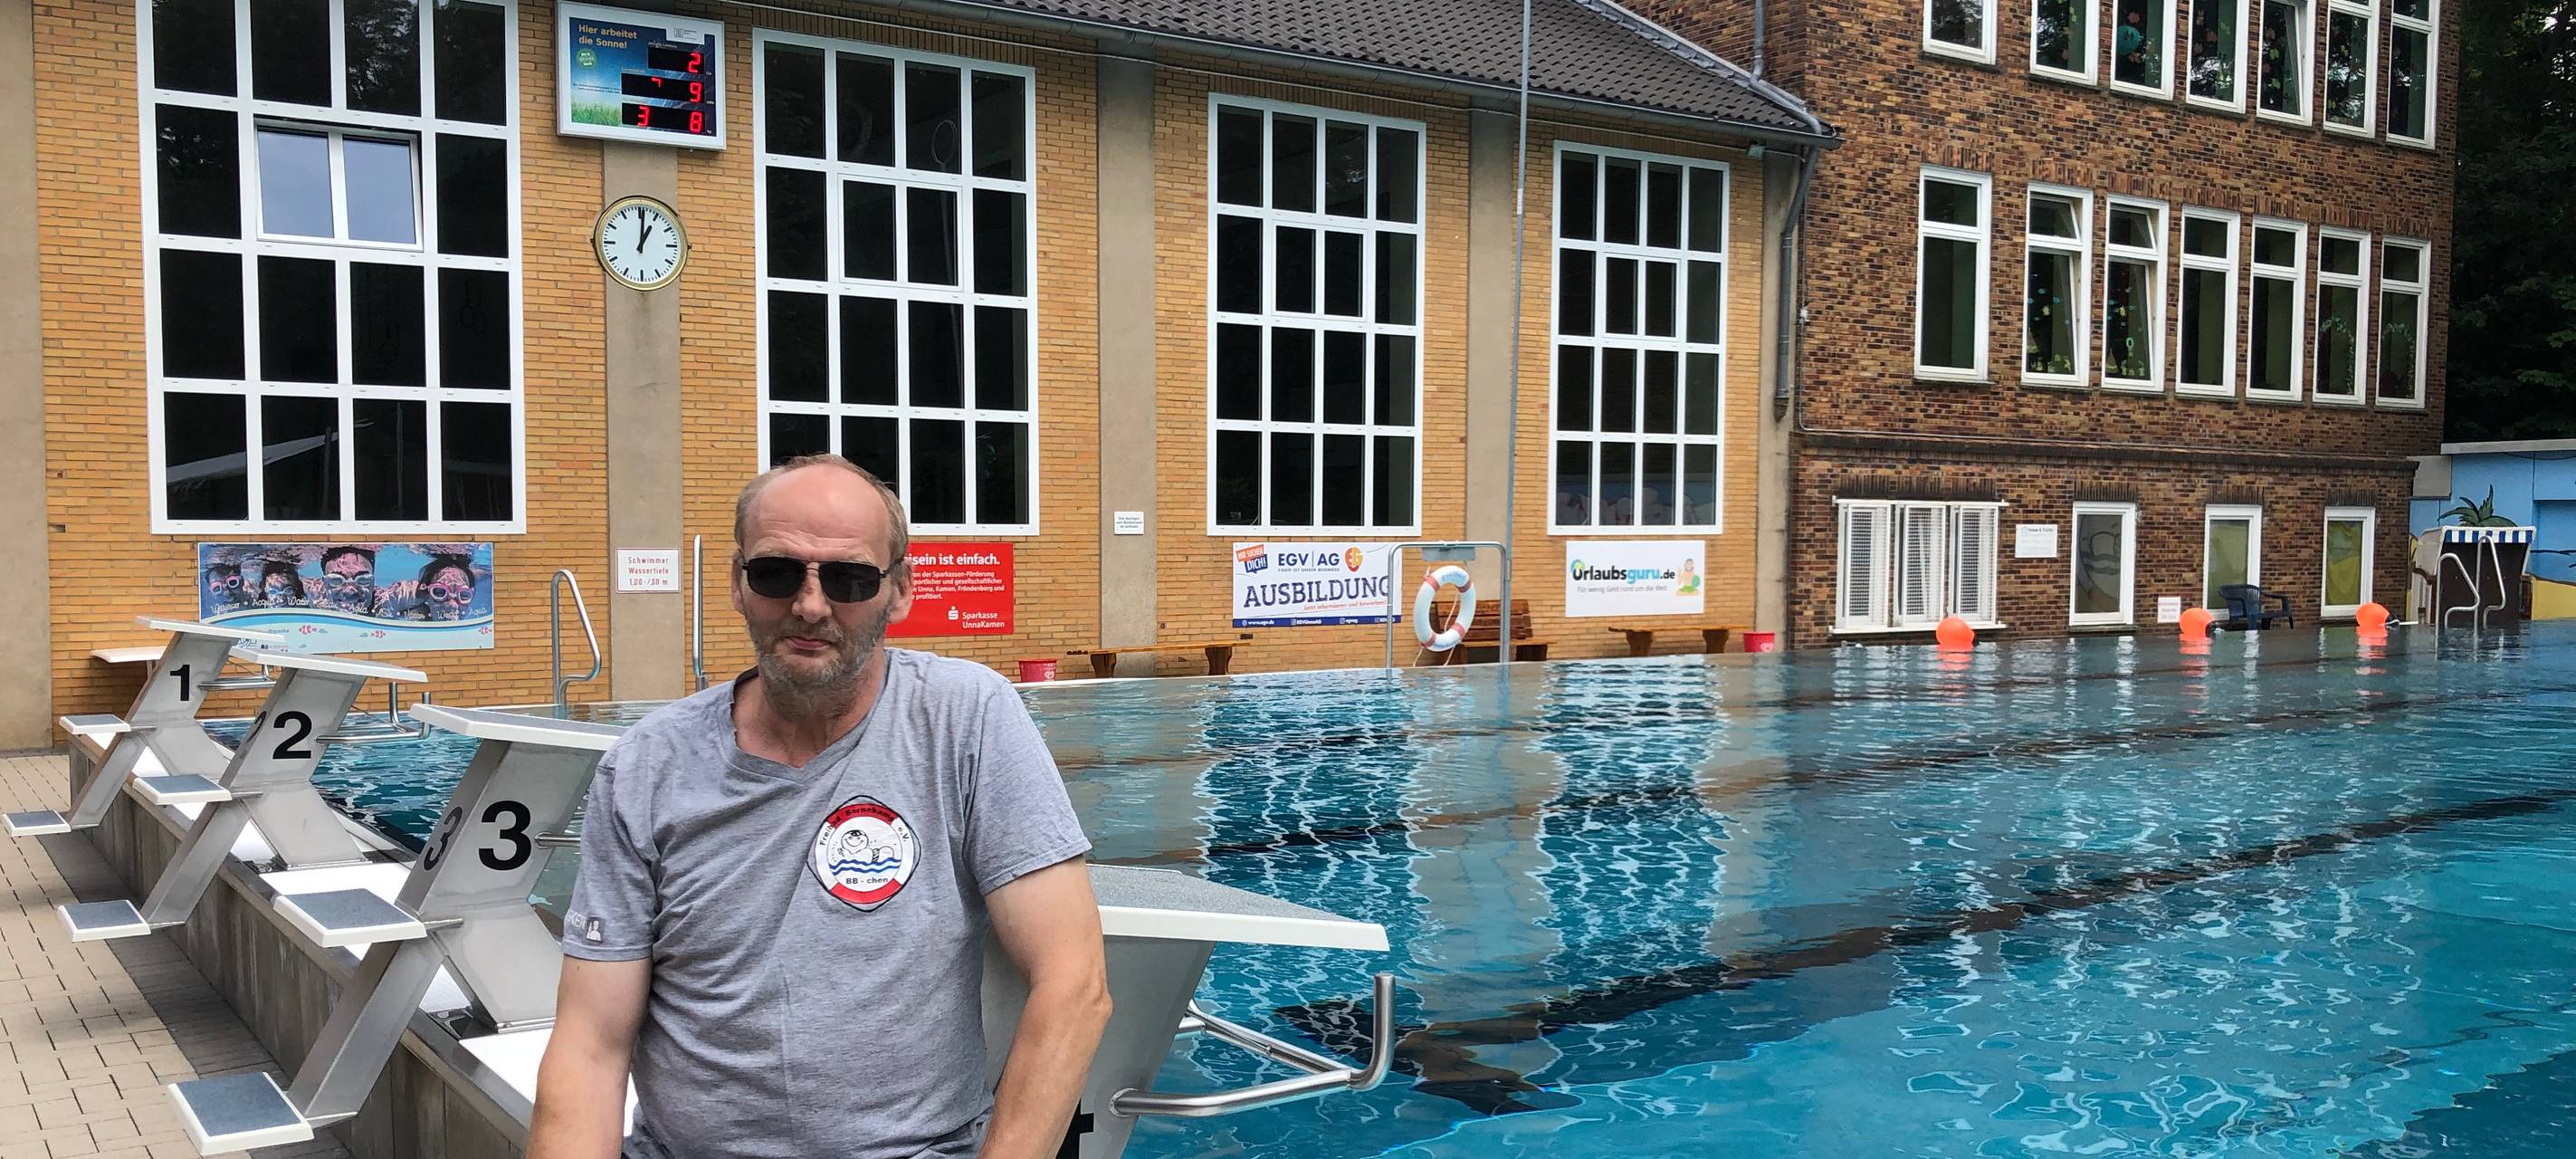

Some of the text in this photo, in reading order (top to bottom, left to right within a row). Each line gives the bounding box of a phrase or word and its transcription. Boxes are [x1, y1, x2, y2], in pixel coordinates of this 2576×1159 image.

[578, 24, 637, 39] Hier arbeitet
[579, 36, 627, 49] die Sonne!
[688, 53, 701, 72] 2
[690, 82, 701, 102] 9
[637, 106, 702, 132] 3 8
[939, 553, 954, 565] ist
[956, 553, 1000, 565] einfach.
[1247, 556, 1266, 570] DICH!
[1278, 553, 1309, 566] EGV
[1317, 552, 1340, 566] AG
[932, 570, 995, 579] Sparkassen-Förderung
[954, 578, 1002, 586] gesellschaftlicher
[962, 611, 997, 620] Sparkasse
[169, 665, 190, 701] 1
[272, 711, 311, 759] 2
[479, 800, 531, 870] 3
